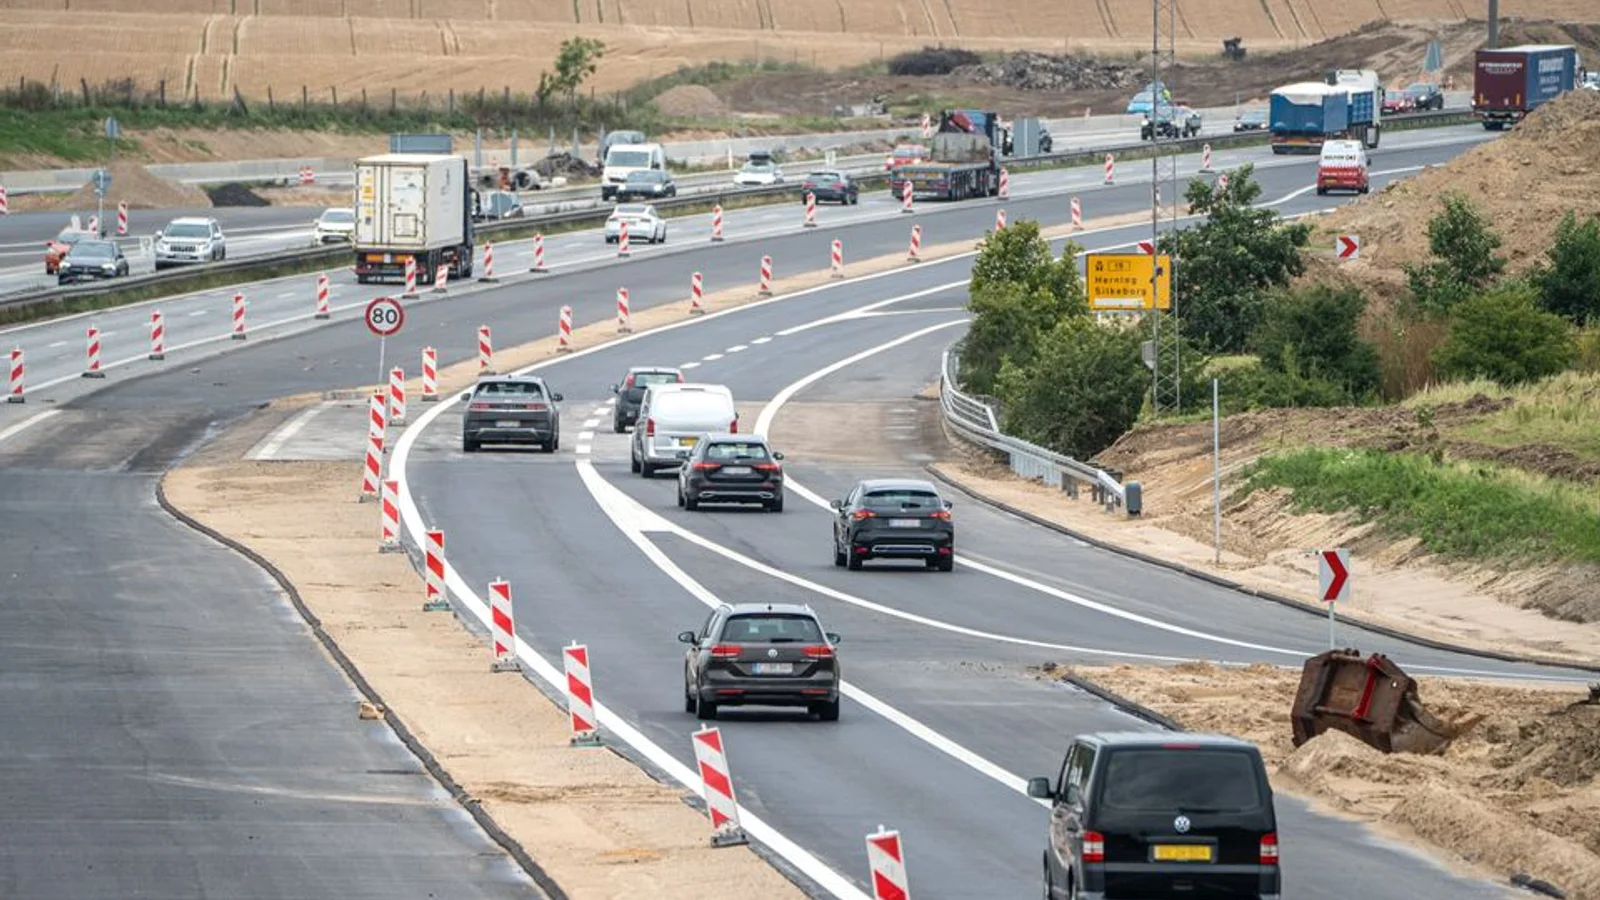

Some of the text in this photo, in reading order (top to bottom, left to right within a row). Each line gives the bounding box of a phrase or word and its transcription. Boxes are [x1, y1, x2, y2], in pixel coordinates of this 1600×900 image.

[1095, 276, 1137, 285] Herning
[1095, 287, 1147, 297] Silkeborg
[372, 307, 398, 324] 80
